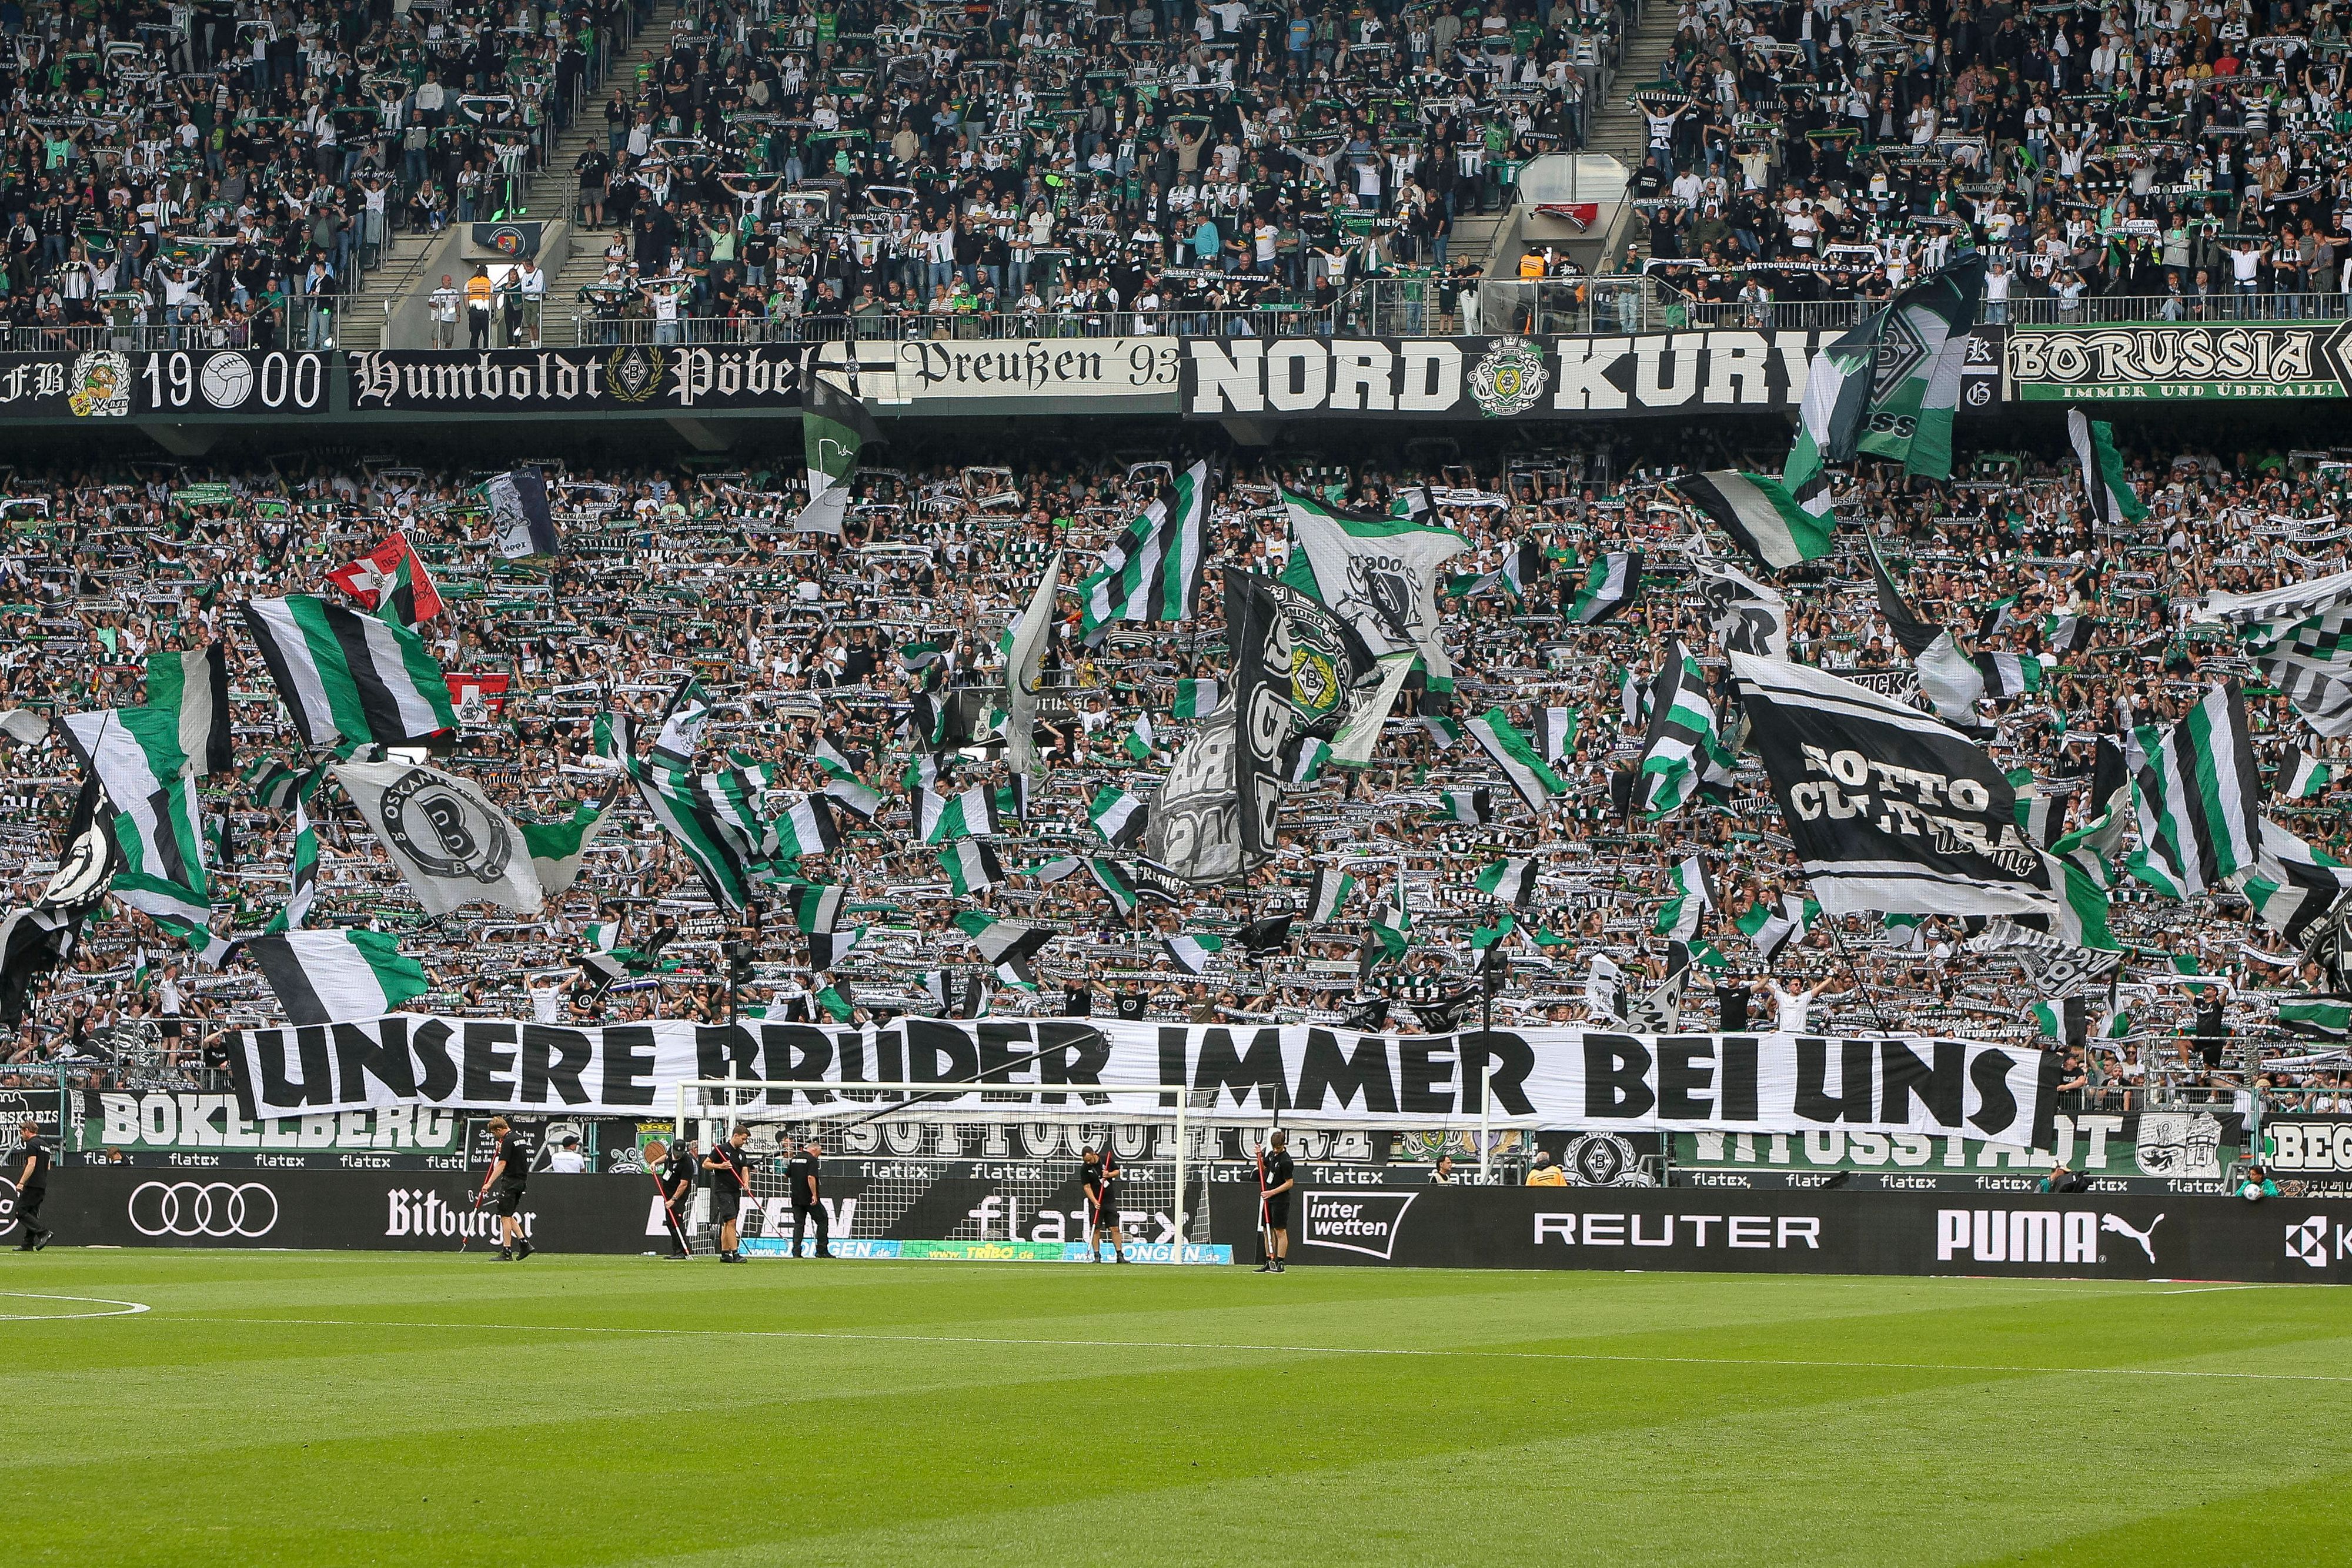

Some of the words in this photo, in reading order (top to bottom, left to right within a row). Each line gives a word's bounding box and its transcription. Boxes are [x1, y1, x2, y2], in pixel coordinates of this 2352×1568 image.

[1190, 338, 1462, 414] NORD
[1553, 330, 1855, 411] KURV
[2009, 330, 2314, 383] BORUSSIA
[142, 353, 192, 409] 19
[260, 353, 322, 409] 00
[356, 350, 603, 407] Humboldt
[2062, 386, 2147, 399] IMMER
[2159, 385, 2210, 398] UND
[2215, 382, 2335, 398] ÜBERALL!
[1288, 607, 1325, 626] NORD
[392, 831, 406, 842] 20
[254, 1017, 656, 1106] UNSERE
[695, 1018, 1112, 1106] BRÜDER
[1158, 1027, 1538, 1116] IMMER
[1583, 1033, 1759, 1121] BEI
[1793, 1037, 2019, 1136] UNS
[169, 1152, 219, 1167] flatex
[253, 1153, 305, 1168] flatex
[339, 1154, 391, 1168] flatex
[860, 1161, 929, 1179] flatex
[971, 1162, 1041, 1180] flatex
[1312, 1166, 1384, 1185] flatex
[1692, 1172, 1749, 1188] flatex
[1880, 1174, 1936, 1190] flatex
[1975, 1176, 2032, 1191] flatex
[1309, 1195, 1364, 1220] inter
[1314, 1217, 1389, 1239] wetten
[1534, 1212, 1821, 1250] REUTER
[1936, 1208, 2098, 1264] PUMA
